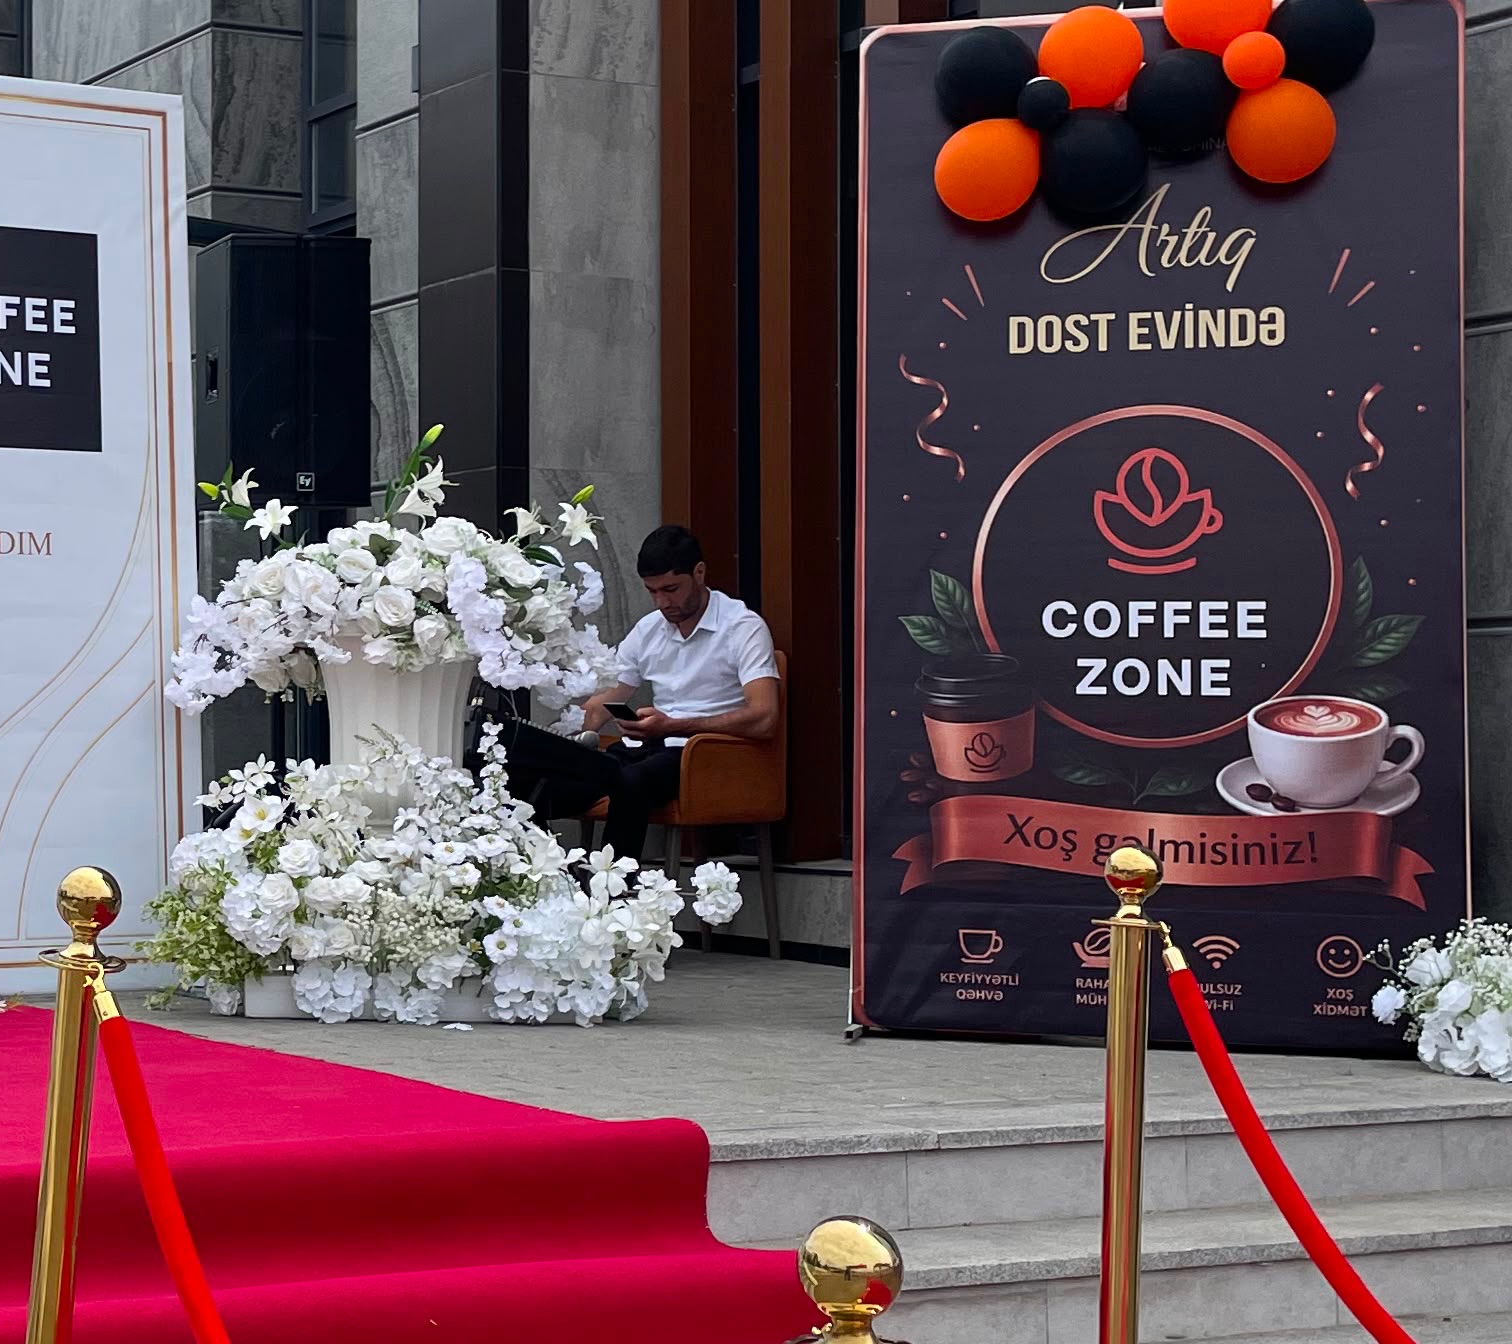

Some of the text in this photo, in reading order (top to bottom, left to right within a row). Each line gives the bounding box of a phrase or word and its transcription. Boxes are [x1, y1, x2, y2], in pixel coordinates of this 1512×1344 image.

[1008, 302, 1286, 355] DOST EVİNDƏ
[1041, 599, 1268, 640] COFFEE
[1075, 657, 1232, 697] ZONE
[1003, 812, 1078, 862] Xoş
[940, 972, 1020, 987] KEYFİYYƏTLİ
[1075, 977, 1111, 990] RAHA
[956, 988, 1004, 1001] QƏHVƏ
[1196, 982, 1243, 996] ULSUZ
[1326, 987, 1355, 1001] XOŞ
[1076, 992, 1107, 1006] MÜH
[1312, 1001, 1369, 1018] XİDMƏT
